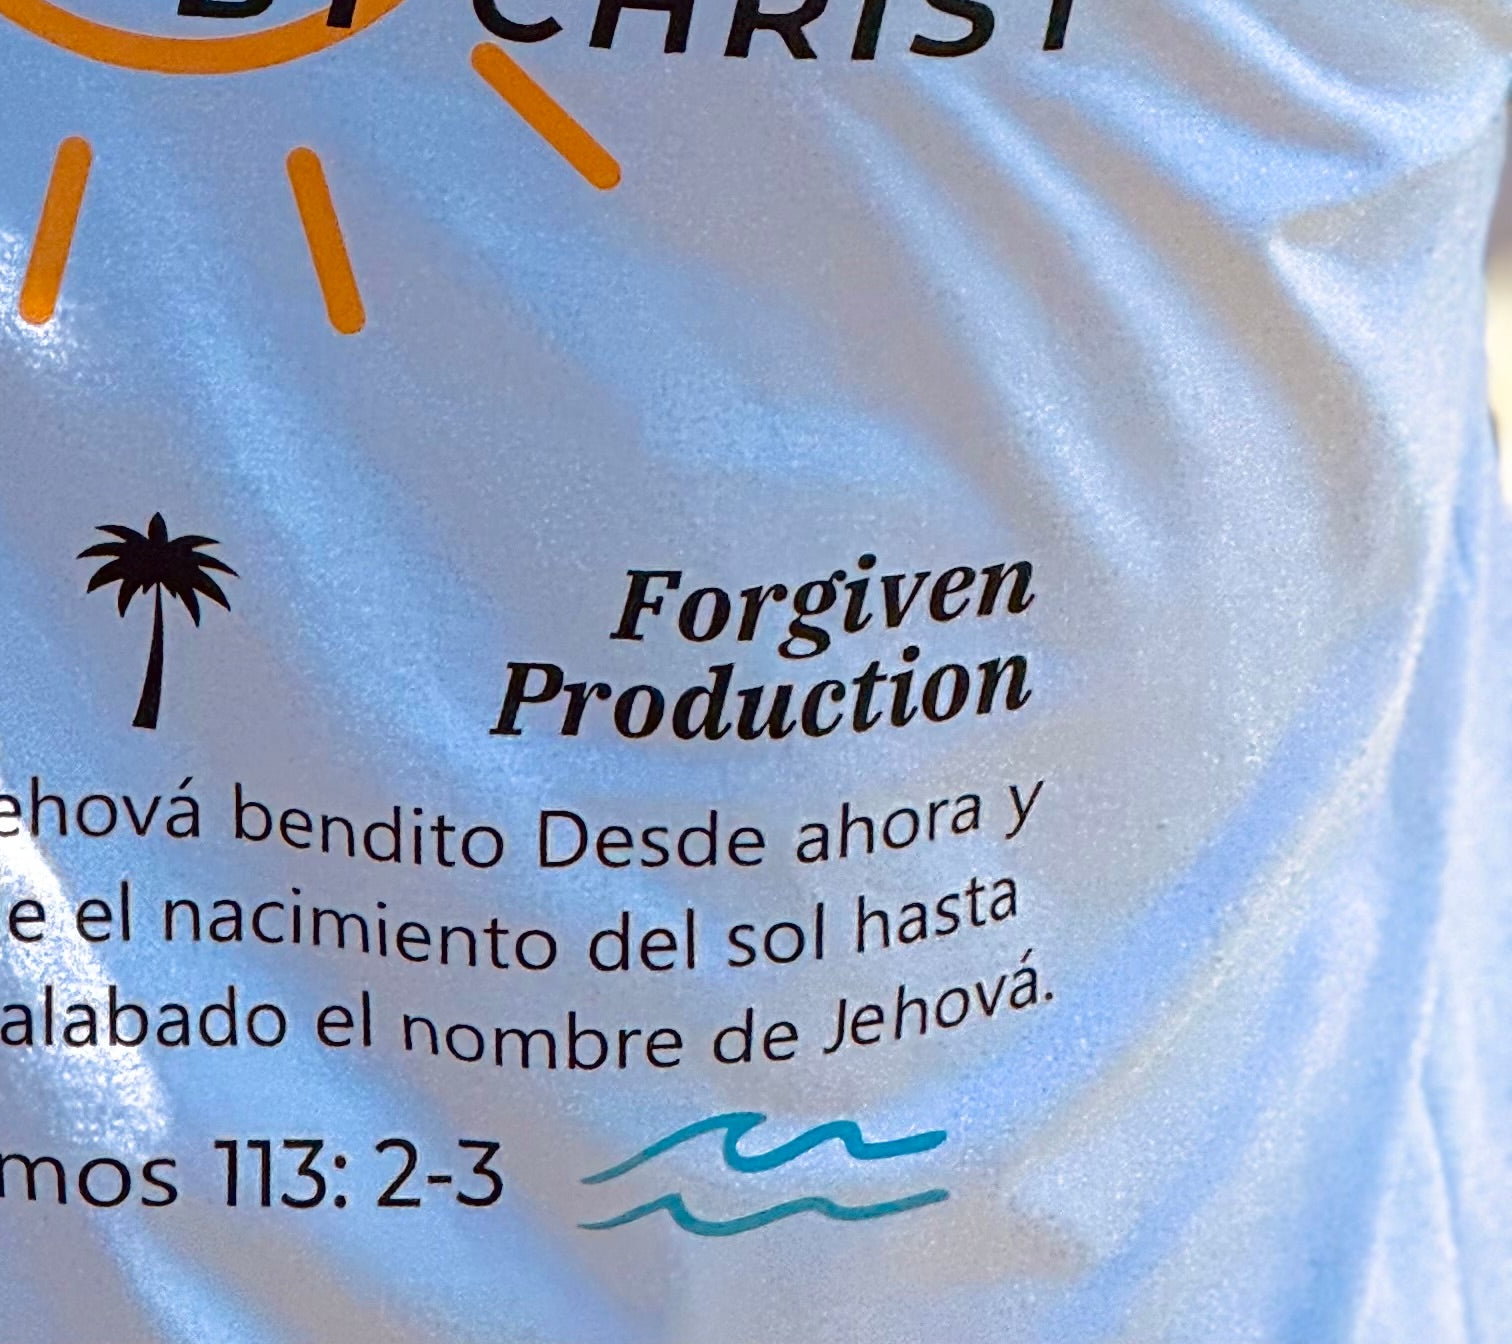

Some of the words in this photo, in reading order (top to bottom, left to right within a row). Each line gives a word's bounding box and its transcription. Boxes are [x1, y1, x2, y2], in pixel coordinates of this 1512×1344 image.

[608, 553, 1036, 660] Forgiven
[488, 644, 1033, 742] Production
[233, 781, 505, 870] bendito
[538, 808, 767, 870] Desde
[795, 793, 982, 865] ahora
[1004, 779, 1045, 841] y
[75, 879, 131, 944] el
[164, 886, 558, 972] nacimiento
[588, 907, 696, 973] del
[727, 901, 825, 969] sol
[856, 876, 1018, 954] hasta
[0, 984, 288, 1048] alabado
[316, 989, 373, 1049] el
[402, 1010, 684, 1072] nombre
[712, 1006, 800, 1065] de
[822, 946, 1055, 1056] Jehová.
[213, 1138, 348, 1210] 113:
[374, 1137, 505, 1209] 2-3
